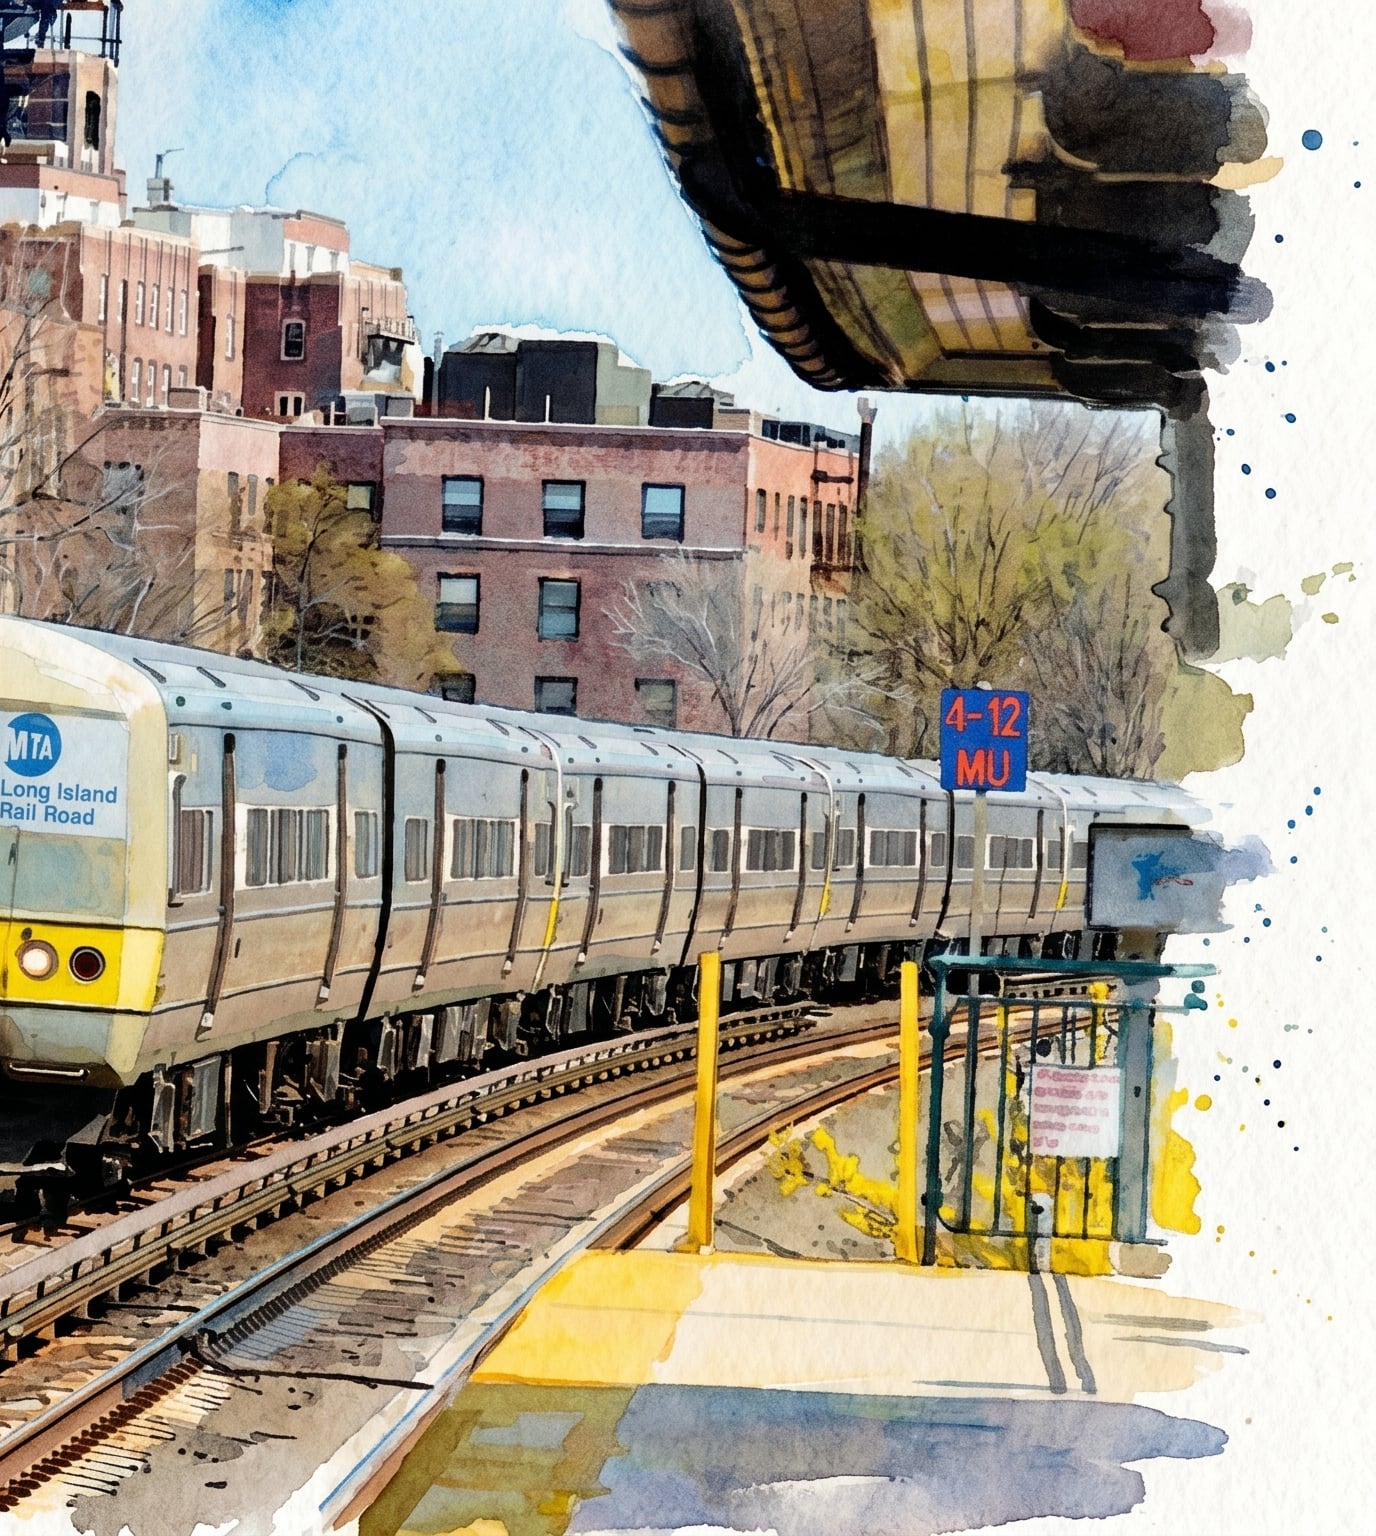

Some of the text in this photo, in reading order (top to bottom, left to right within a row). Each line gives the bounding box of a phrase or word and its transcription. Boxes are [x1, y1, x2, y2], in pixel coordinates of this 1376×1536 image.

[945, 696, 1021, 736] 4-12
[5, 727, 53, 761] MTA
[956, 749, 1010, 787] MU
[0, 779, 117, 803] Long Island
[0, 802, 95, 825] Rail Road
